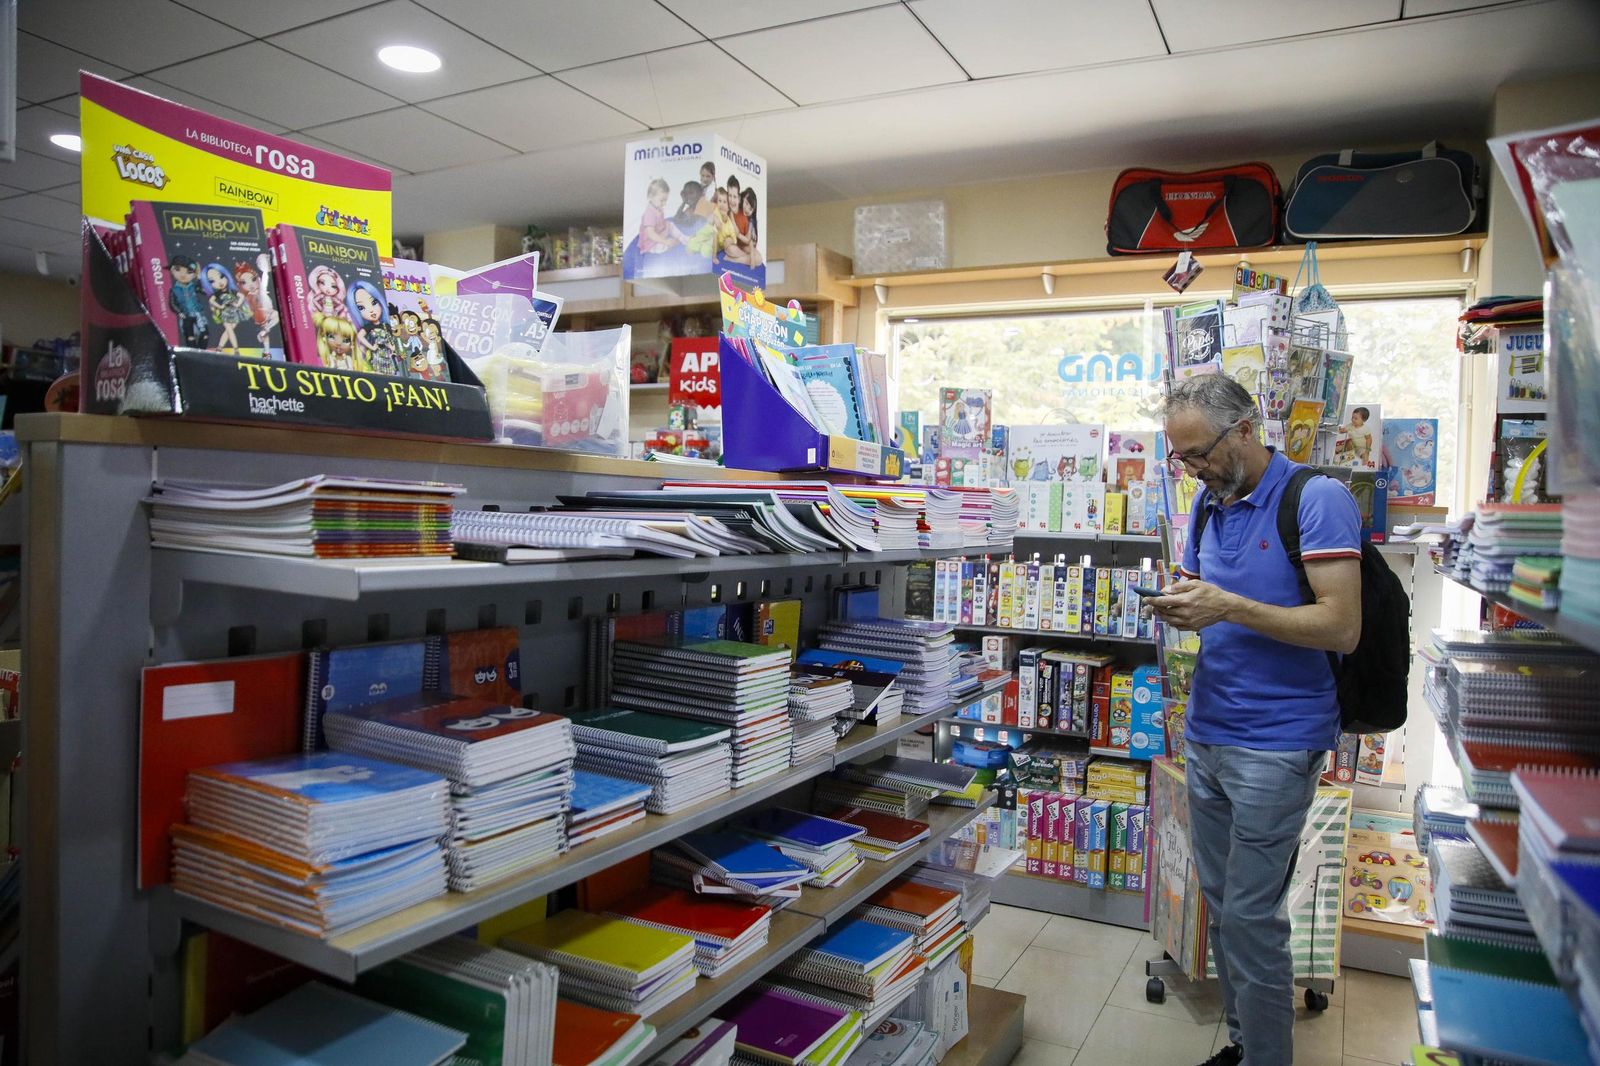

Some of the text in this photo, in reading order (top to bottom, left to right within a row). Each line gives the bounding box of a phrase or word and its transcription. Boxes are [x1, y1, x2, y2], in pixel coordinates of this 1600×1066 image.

[186, 128, 315, 179] LA BIBLIOTECA rosa
[117, 156, 165, 188] LOCOS
[219, 182, 274, 205] RAINBOW
[172, 217, 250, 234] RAINBOW
[202, 231, 226, 239] HIGH
[309, 241, 369, 262] RAINBOW
[151, 257, 164, 285] rosa
[294, 275, 305, 299] rosa
[524, 322, 548, 340] A5
[738, 308, 788, 339] CHAPUZÓN
[1506, 334, 1545, 351] JUGU
[108, 340, 123, 368] La
[680, 352, 720, 373] AP
[96, 378, 126, 402] rosa
[238, 362, 452, 412] TU SITIO ¡FAN!
[249, 392, 305, 412] hachette
[951, 441, 975, 449] Magic
[1032, 803, 1041, 817] Diset
[1048, 805, 1057, 818] Diset
[1064, 807, 1073, 820] Diset
[1081, 809, 1089, 824] Diset
[1095, 814, 1104, 829] Diset
[1116, 815, 1125, 829] Diset
[1132, 816, 1142, 832] Diset
